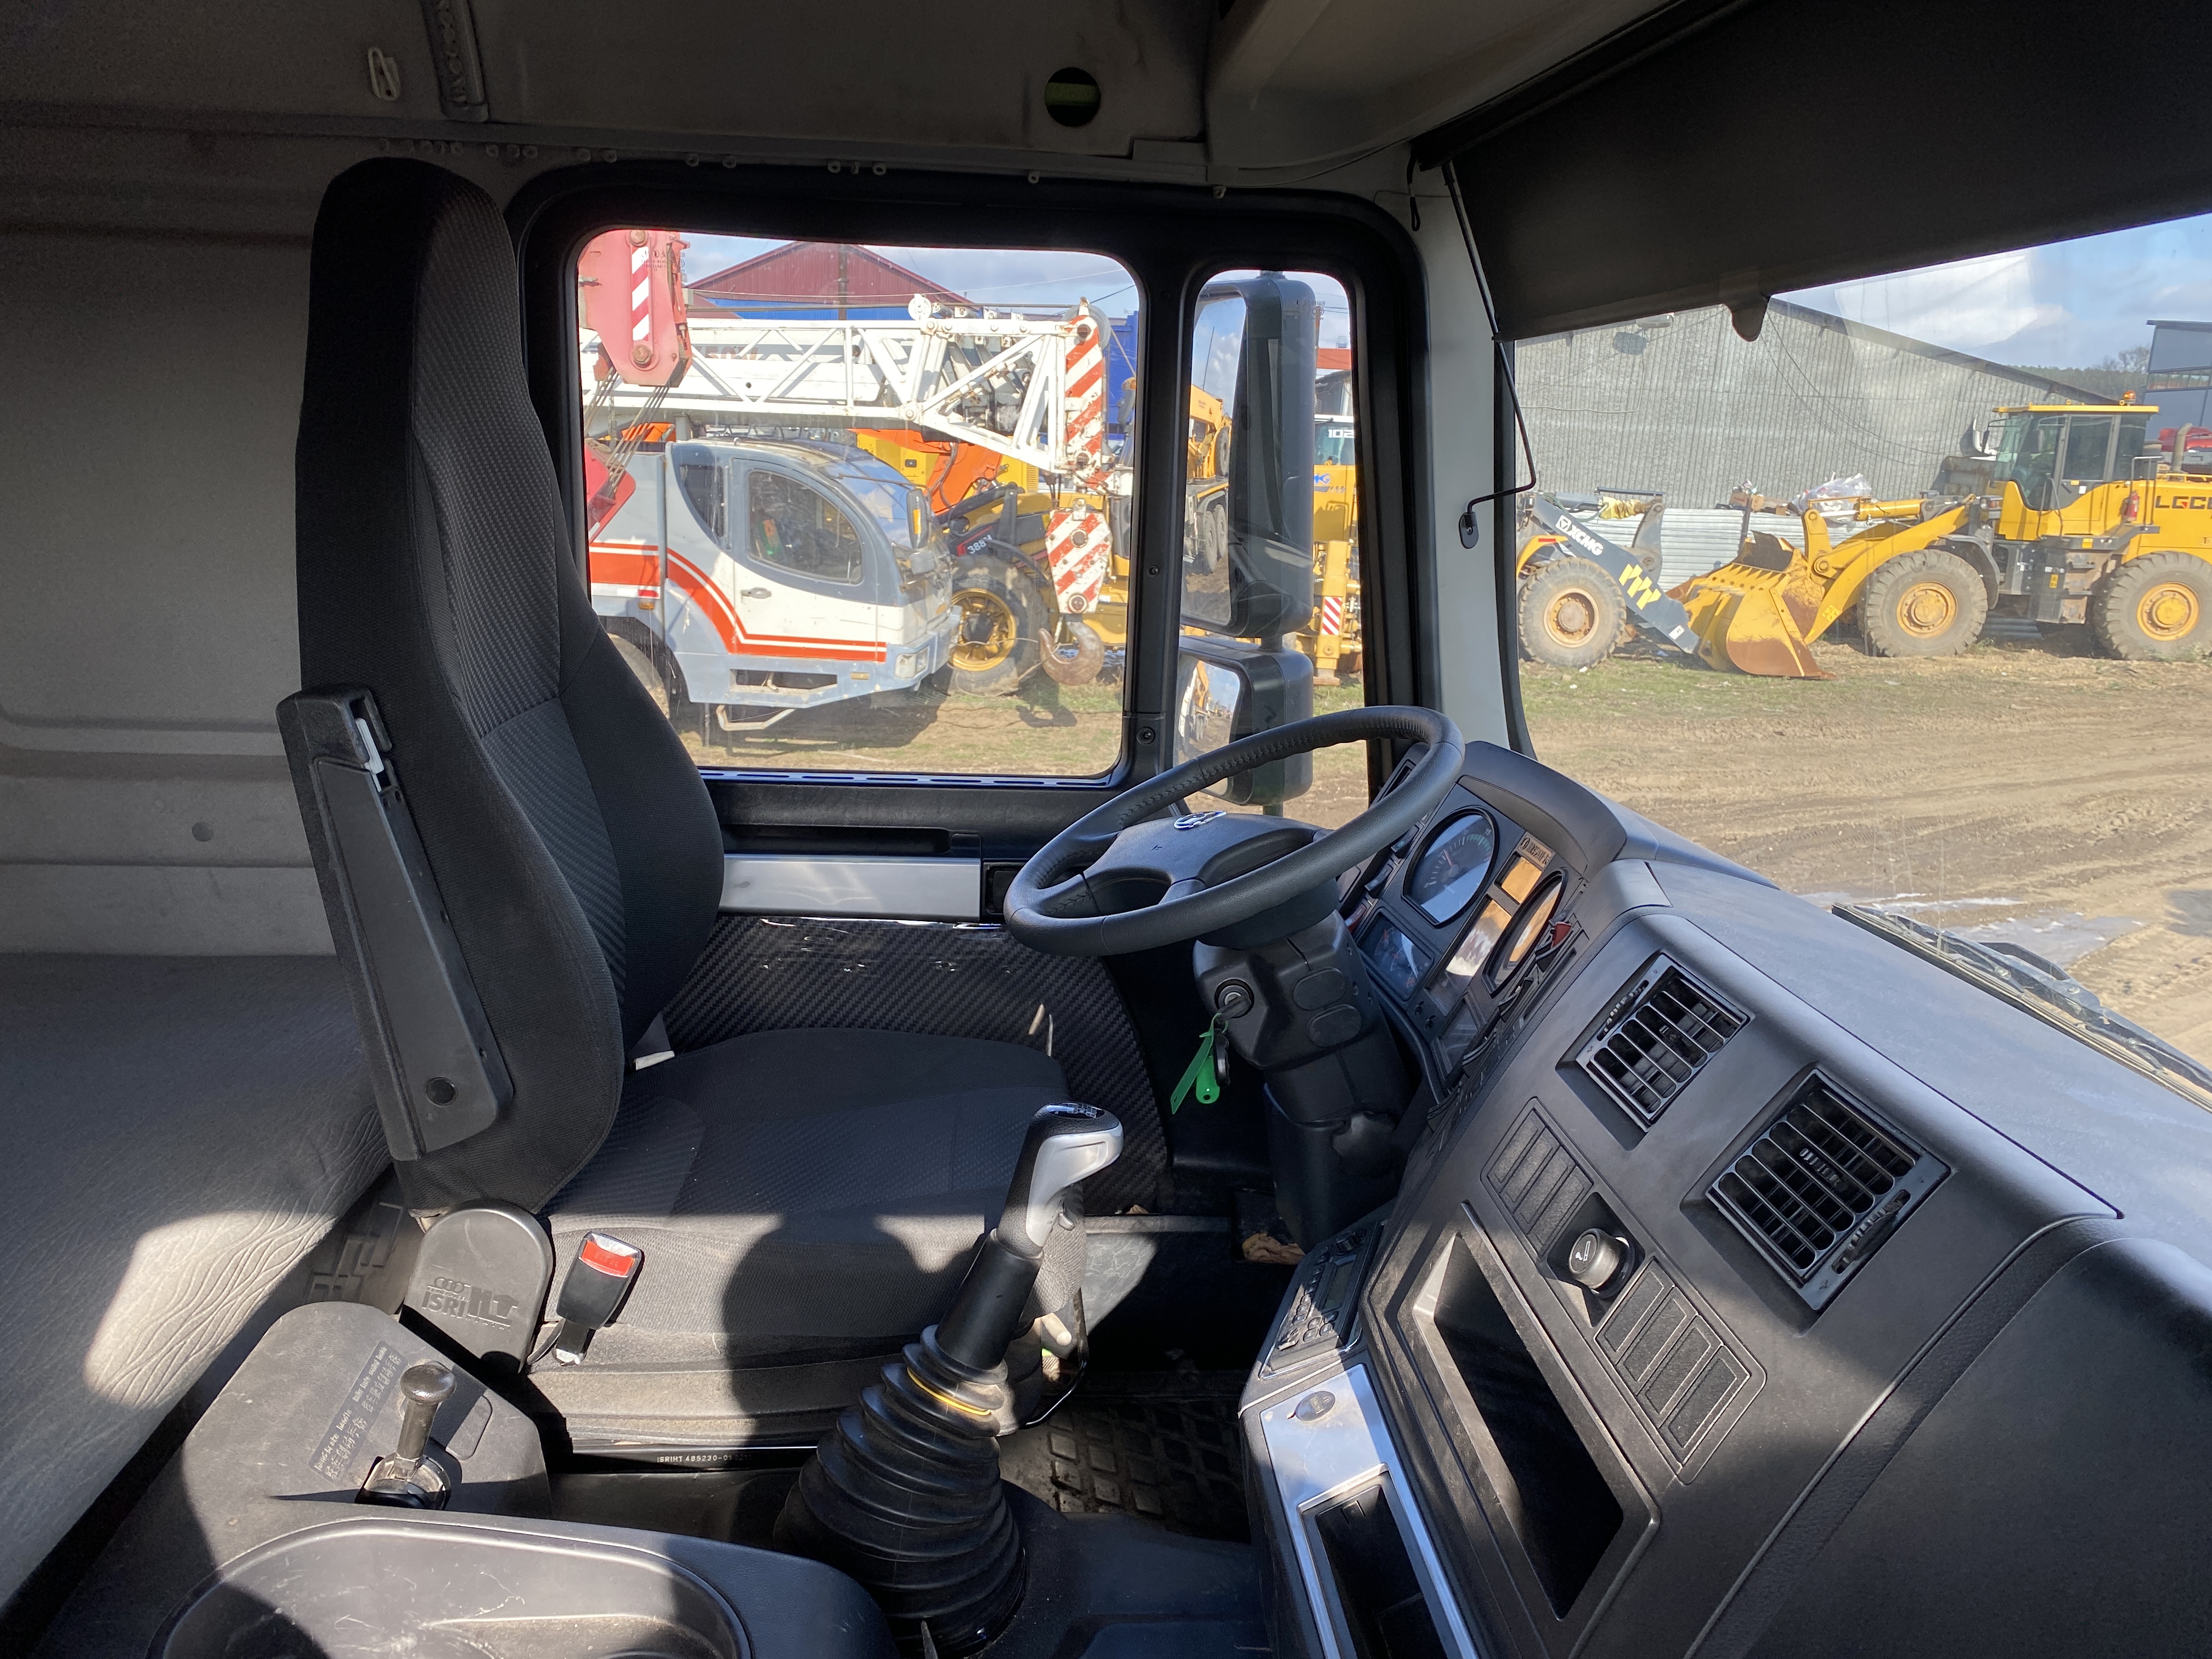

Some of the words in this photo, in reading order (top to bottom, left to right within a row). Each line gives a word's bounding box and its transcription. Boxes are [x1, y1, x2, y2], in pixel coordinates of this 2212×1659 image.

[1566, 524, 1604, 556] XCMG
[421, 1290, 470, 1319] ISRI
[657, 1455, 683, 1463] ISRIHT
